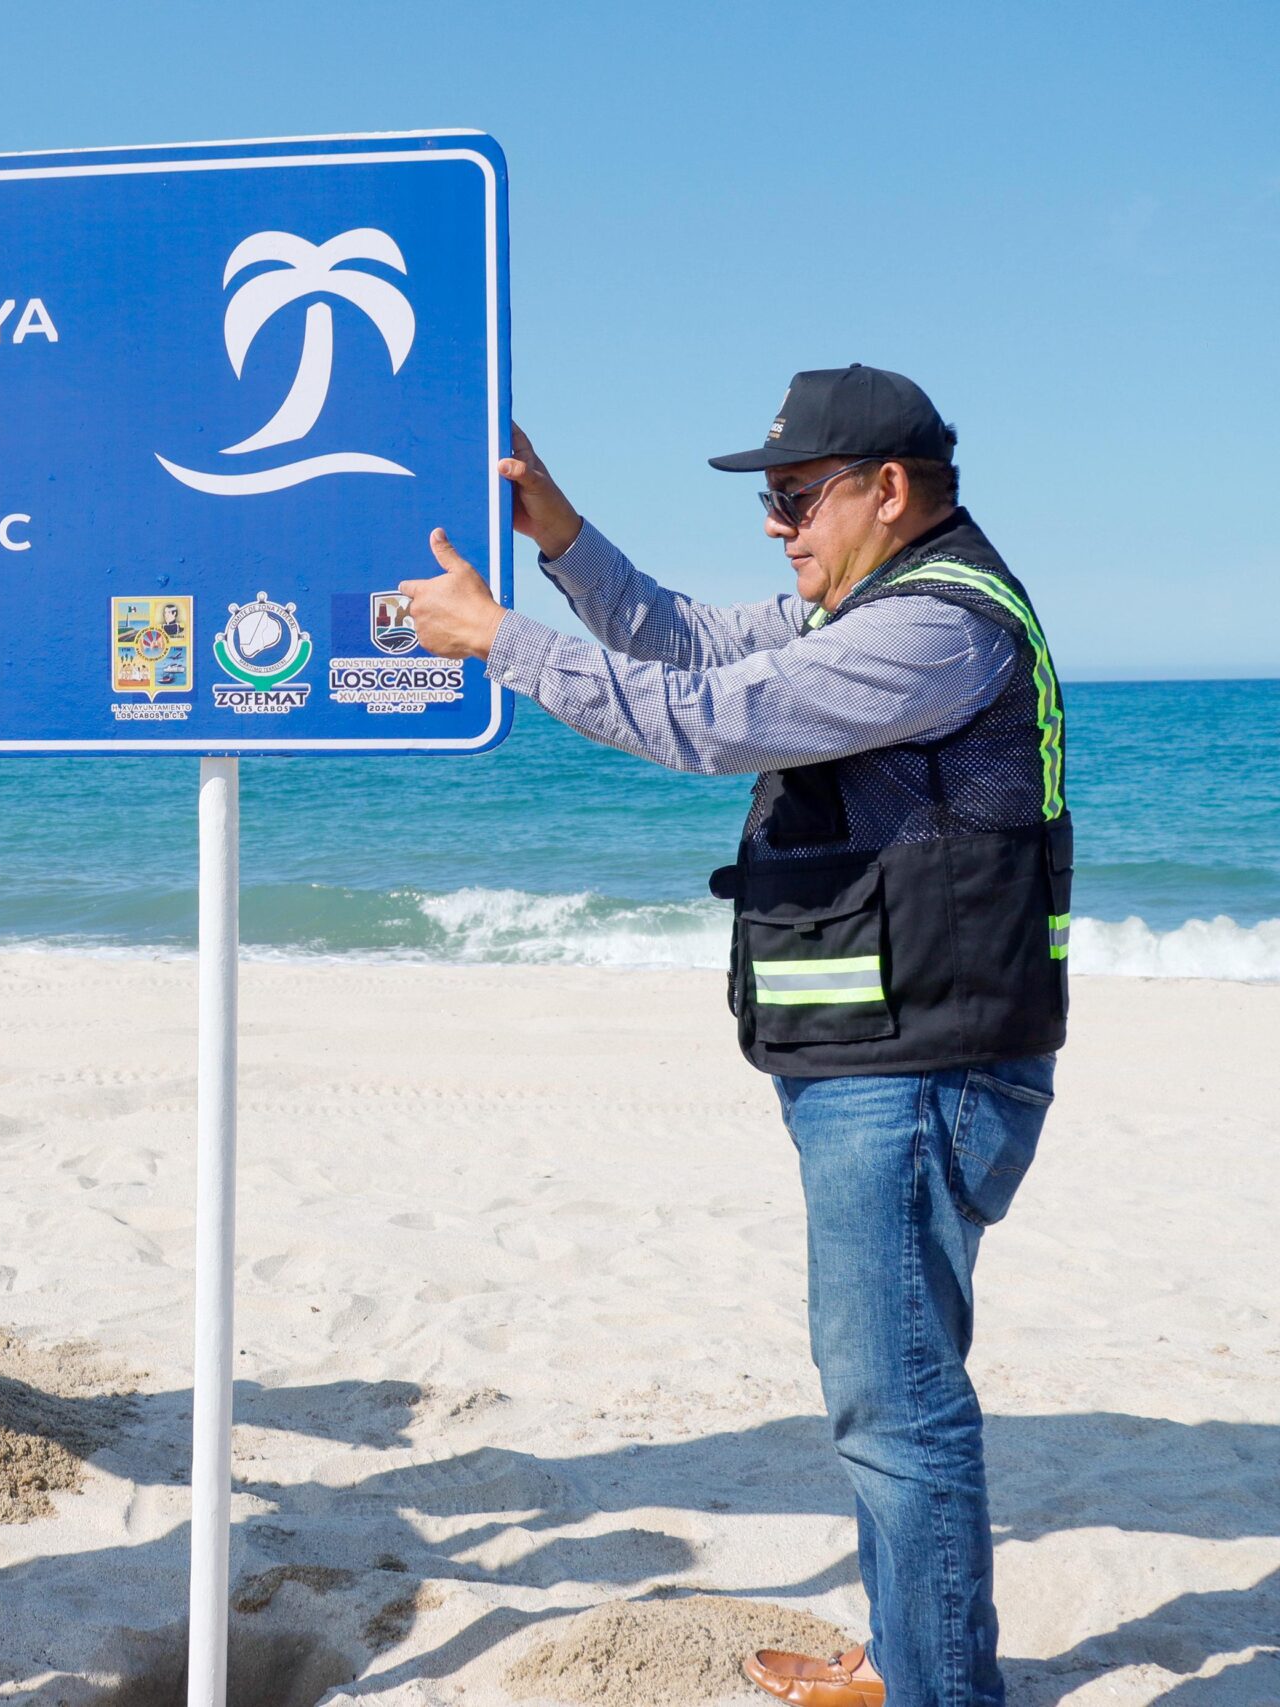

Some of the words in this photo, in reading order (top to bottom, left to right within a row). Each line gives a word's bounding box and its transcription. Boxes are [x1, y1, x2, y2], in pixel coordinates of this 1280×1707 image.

[276, 606, 297, 629] FEDERAL
[331, 659, 415, 668] CONSTRUYENDO
[416, 659, 462, 668] CONTIGO
[331, 671, 376, 688] LOS
[380, 671, 462, 688] CABOS
[217, 692, 308, 706] ZOFEMAT
[340, 692, 356, 701] XV
[357, 692, 454, 701] AYUNTAMIENTO
